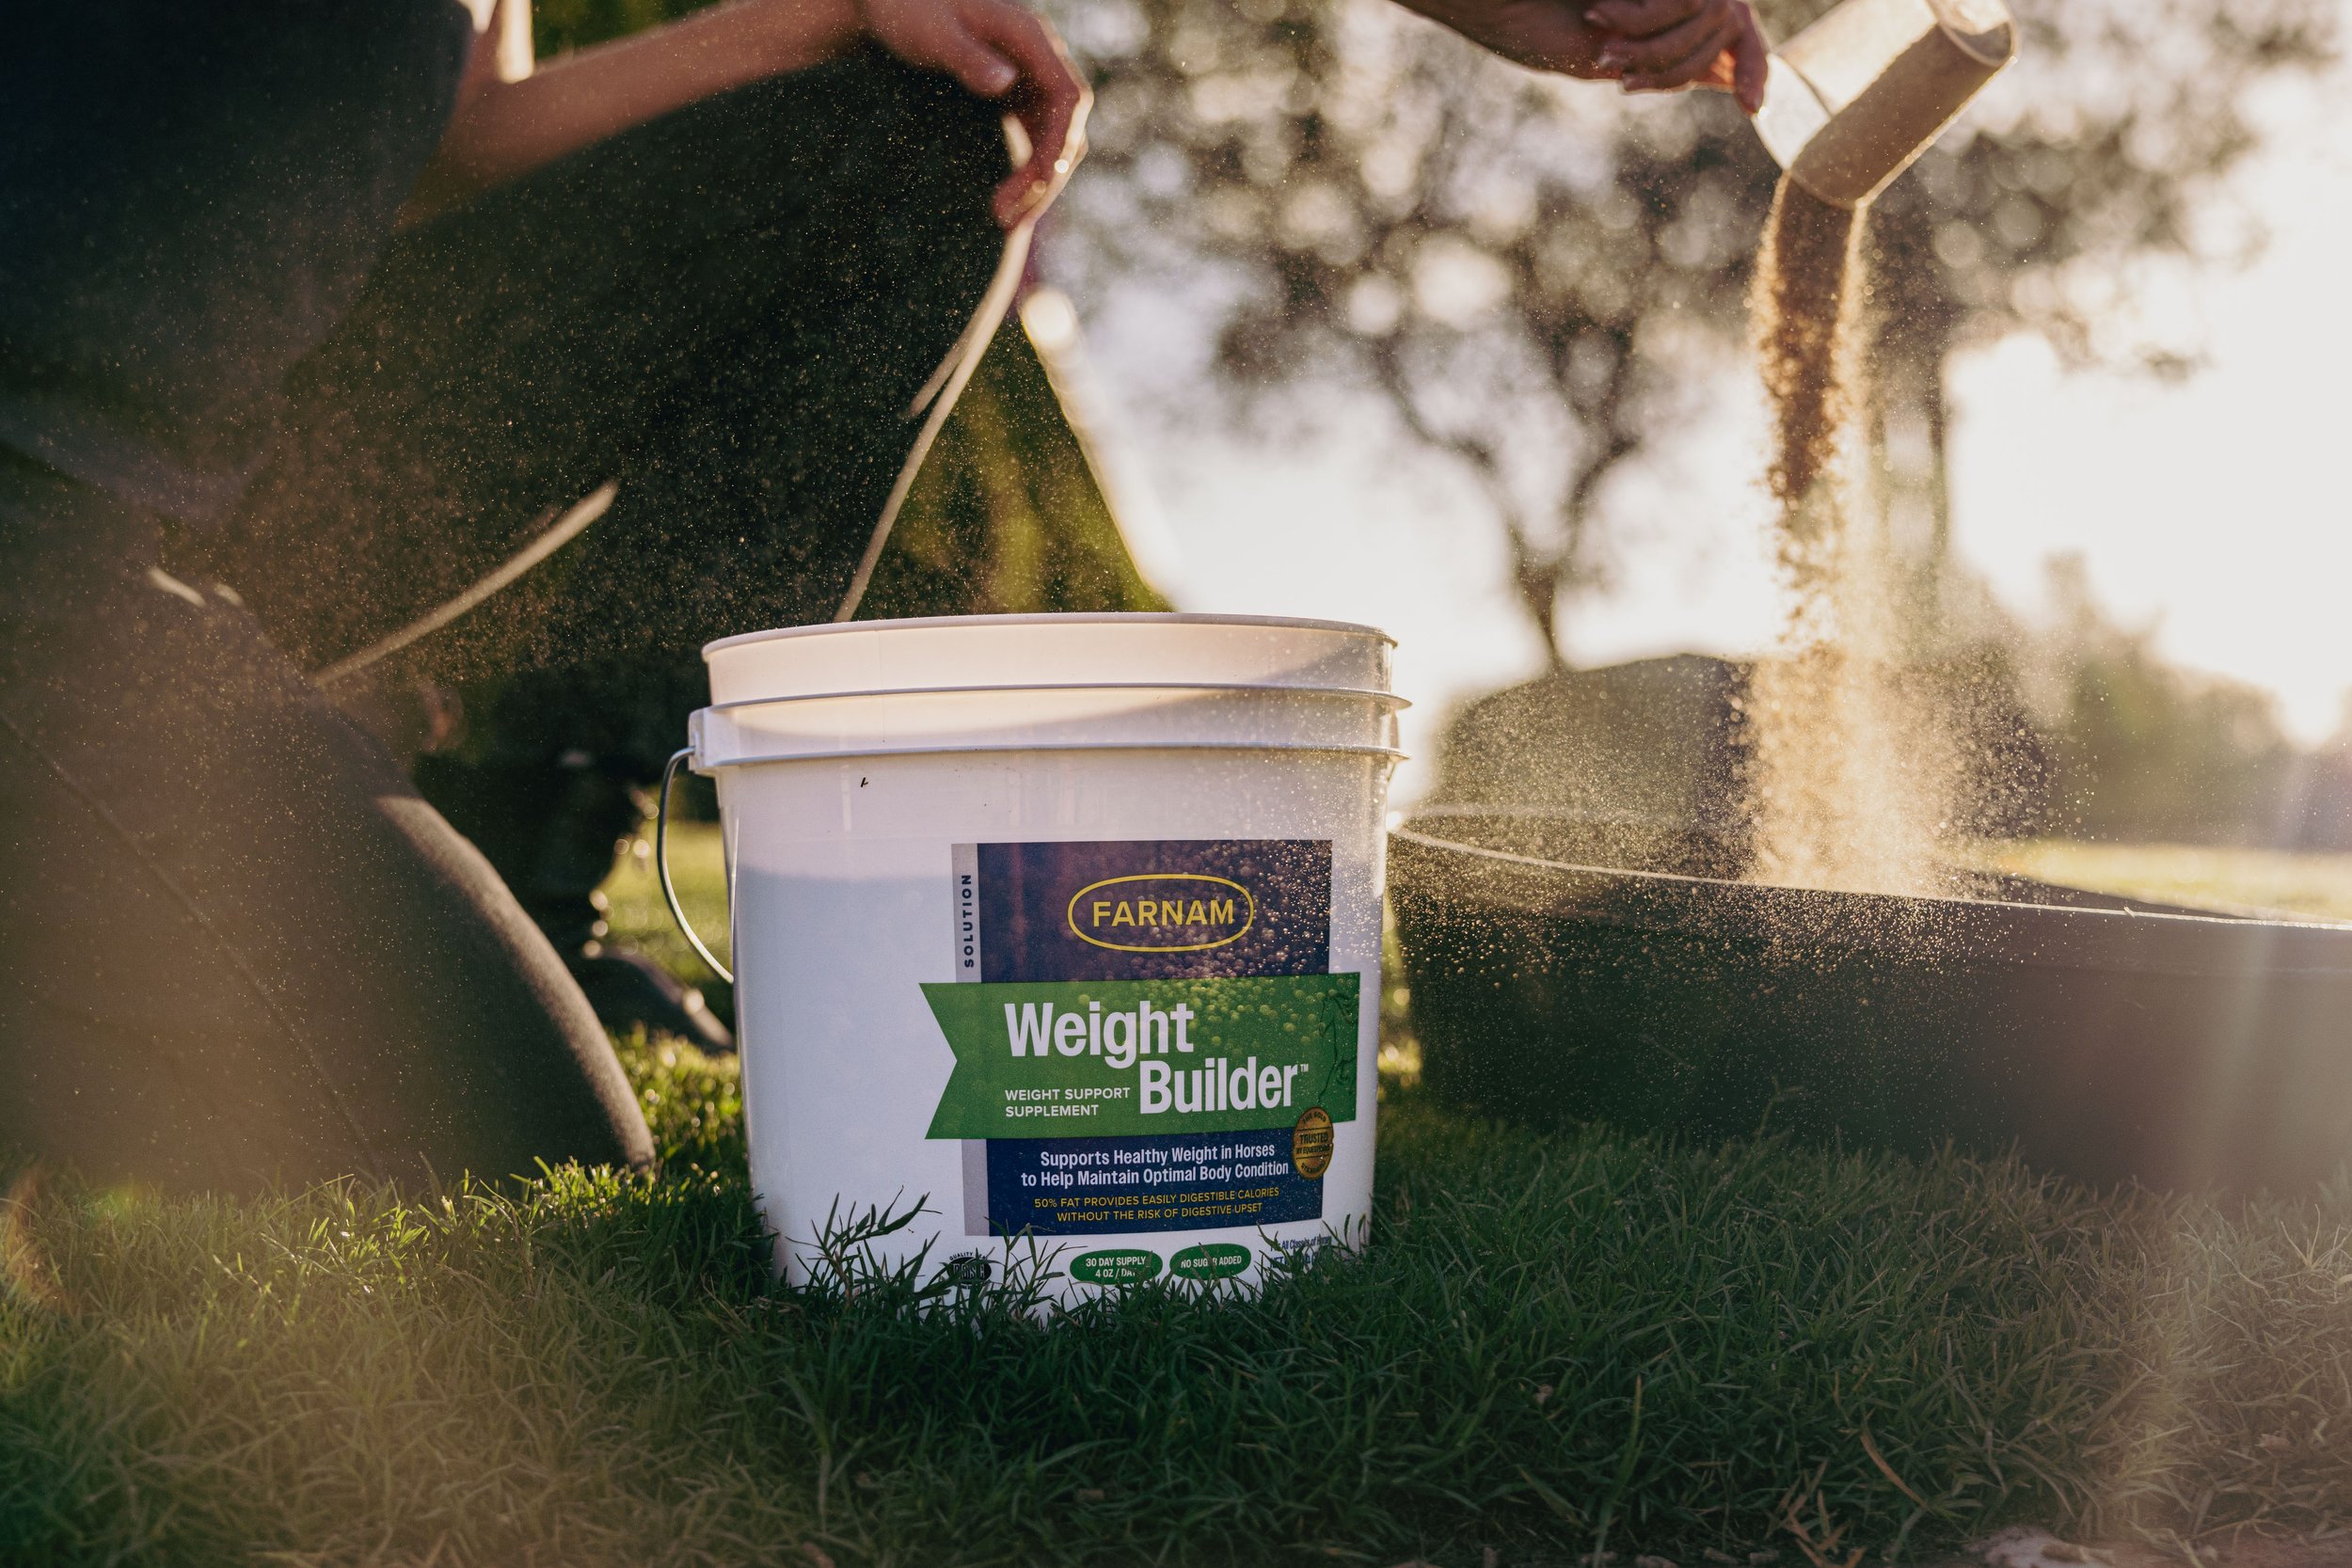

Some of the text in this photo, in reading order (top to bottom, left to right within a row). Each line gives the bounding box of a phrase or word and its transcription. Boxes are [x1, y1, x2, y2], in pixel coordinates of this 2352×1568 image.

[961, 874, 975, 968] SOLUTION
[1093, 899, 1234, 927] FARNAM
[1004, 1000, 1194, 1069] Weight
[1005, 1087, 1131, 1101] WEIGHT SUPPORT
[1005, 1104, 1099, 1117] SUPPLEMENT
[1299, 1132, 1328, 1145] TRUSTED
[1041, 1144, 1276, 1170] Supports Healthy Weight in Horses
[1021, 1172, 1037, 1187] to
[1041, 1171, 1074, 1189] Help
[1077, 1169, 1139, 1186] Maintain
[1143, 1166, 1196, 1186] Optimal
[1200, 1164, 1232, 1182] Body
[1234, 1161, 1289, 1179] Condition
[1034, 1187, 1279, 1208] 50% FAT PROVIDES EASILY DIGESTIBLE CALORIES
[1057, 1202, 1263, 1222] WITHOUT THE RISK OF DIGESTIVE UPSET
[949, 1251, 973, 1260] QUALITY
[1086, 1256, 1147, 1267] 30 DAY SUPPLY
[1181, 1255, 1242, 1268] NO SUGR ADDED
[1095, 1269, 1101, 1277] 4
[1103, 1269, 1113, 1277] OZ
[1121, 1268, 1136, 1277] DA
